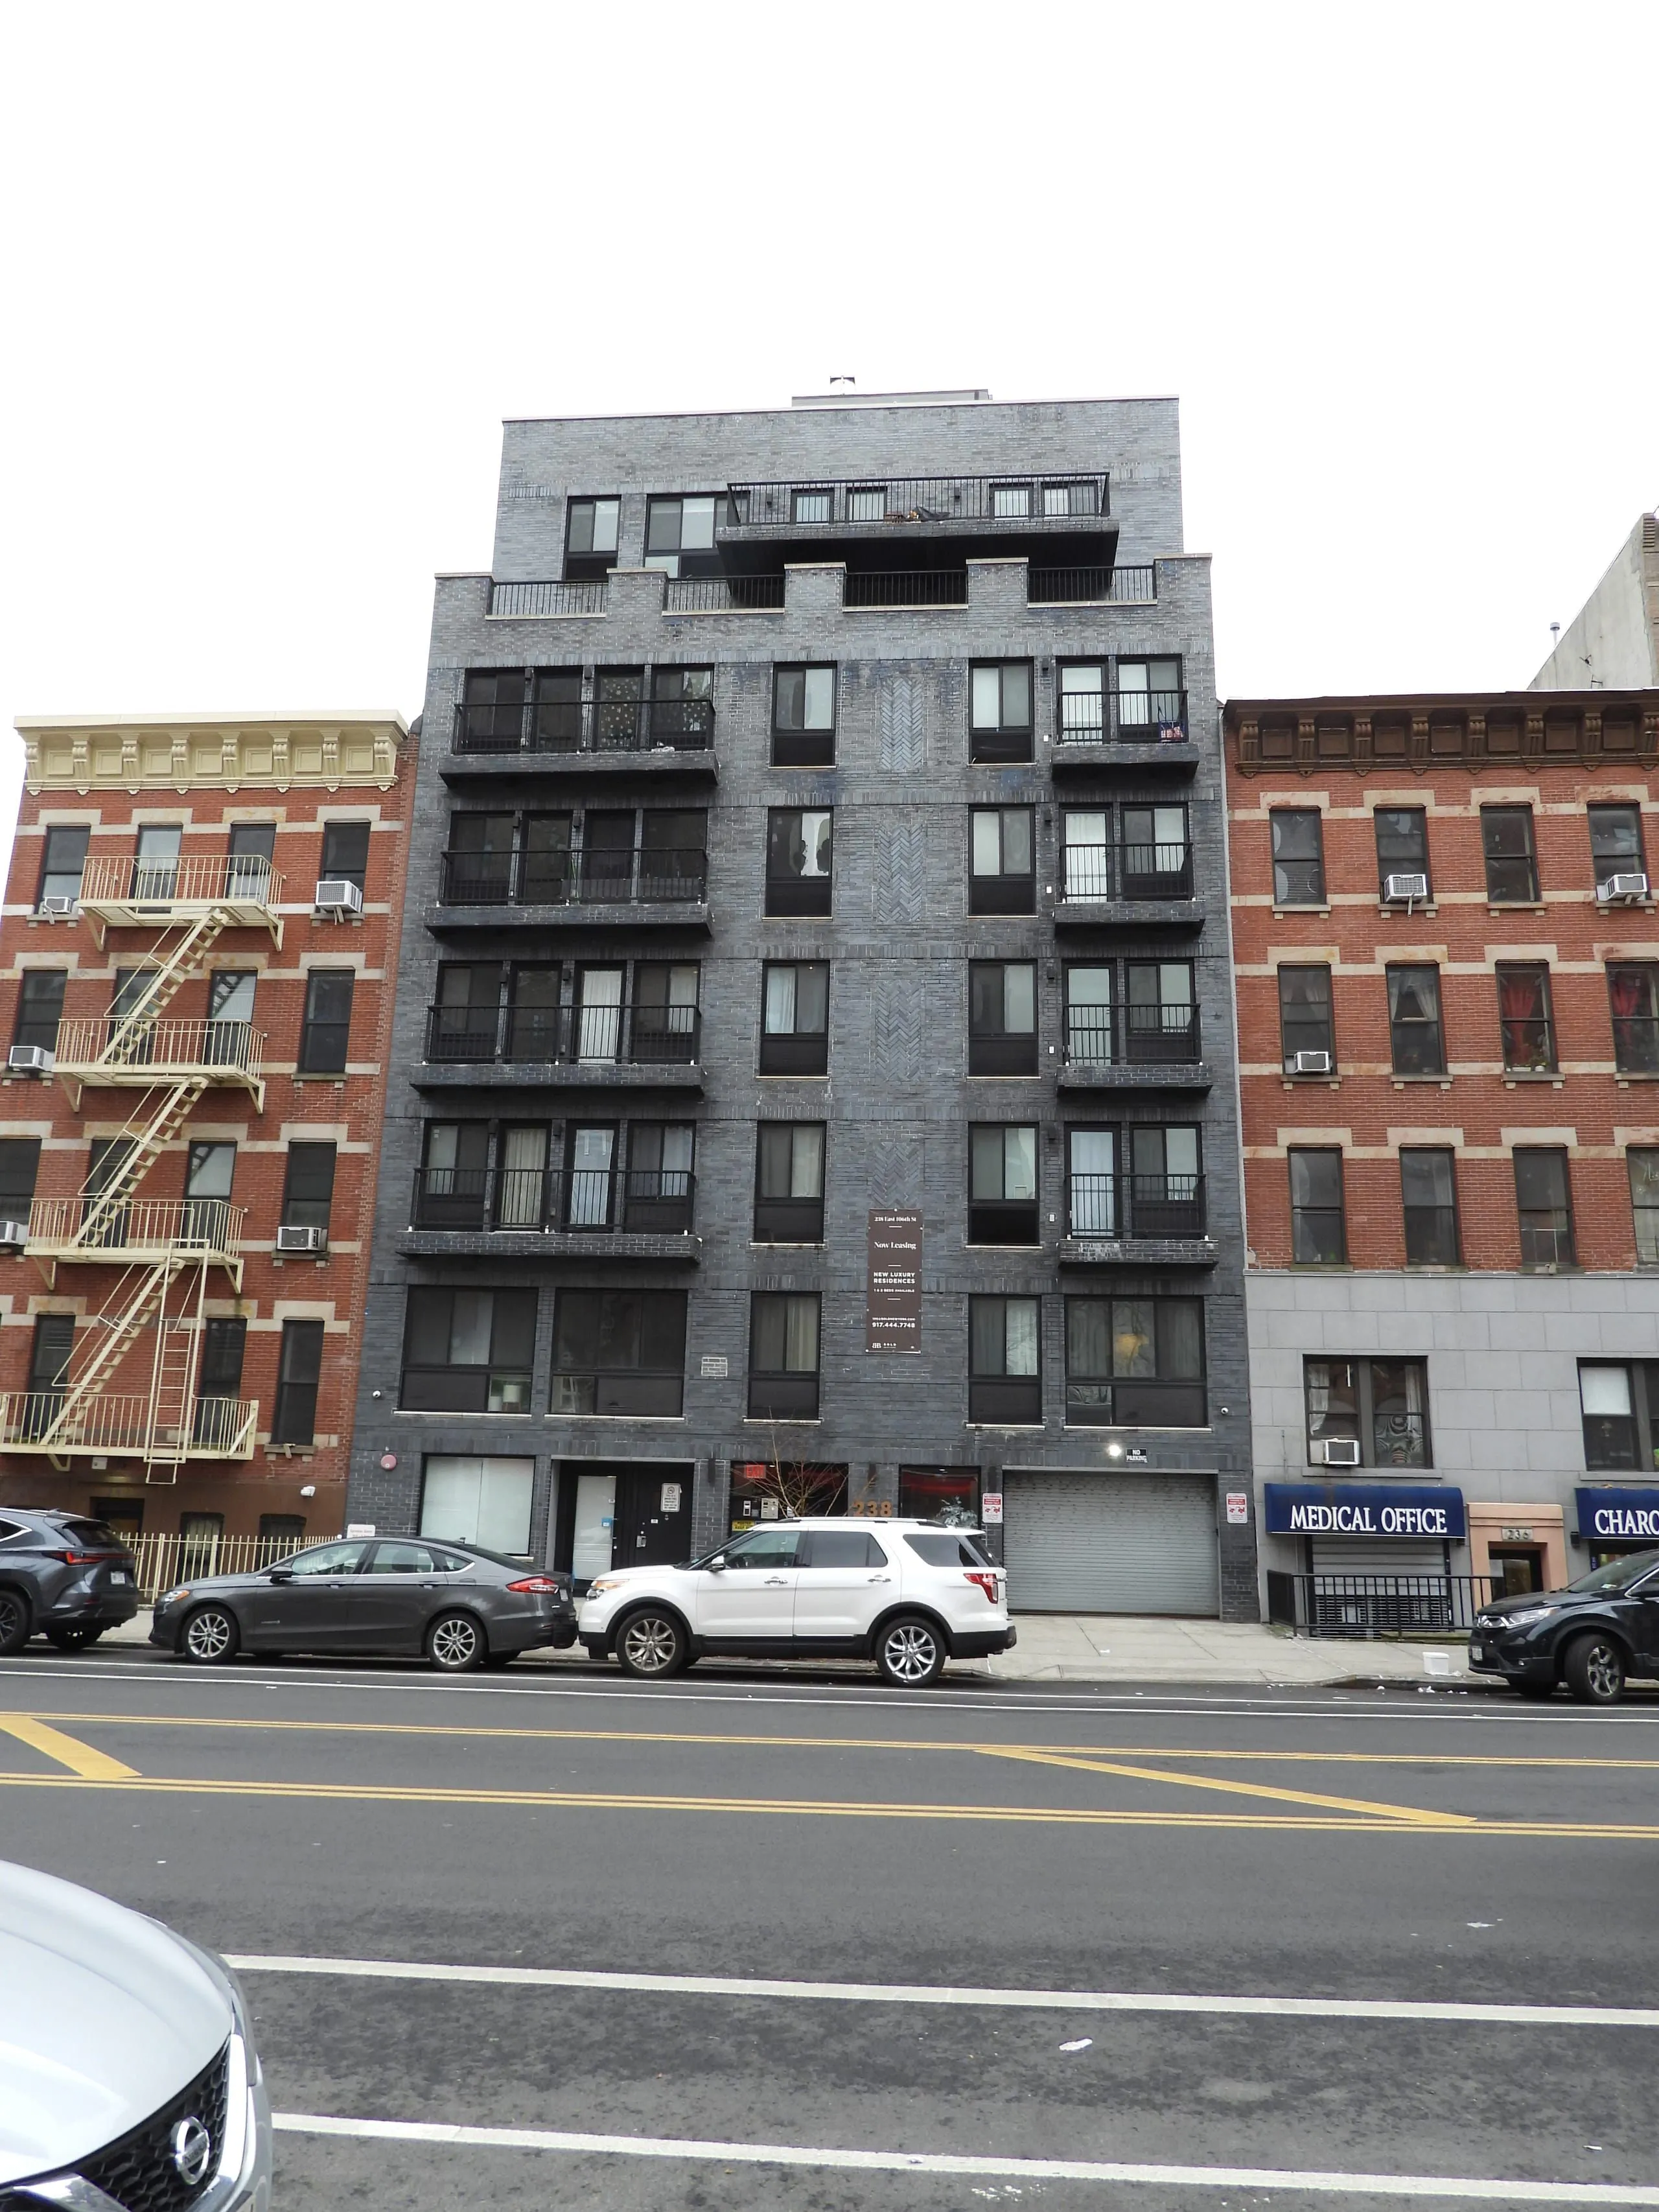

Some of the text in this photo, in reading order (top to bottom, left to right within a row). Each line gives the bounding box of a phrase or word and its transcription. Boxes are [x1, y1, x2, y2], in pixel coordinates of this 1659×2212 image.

[891, 1241, 916, 1250] Leasing
[852, 1500, 892, 1517] 238
[1290, 1505, 1447, 1533] MEDICAL OFFICE
[1508, 1530, 1529, 1539] 236
